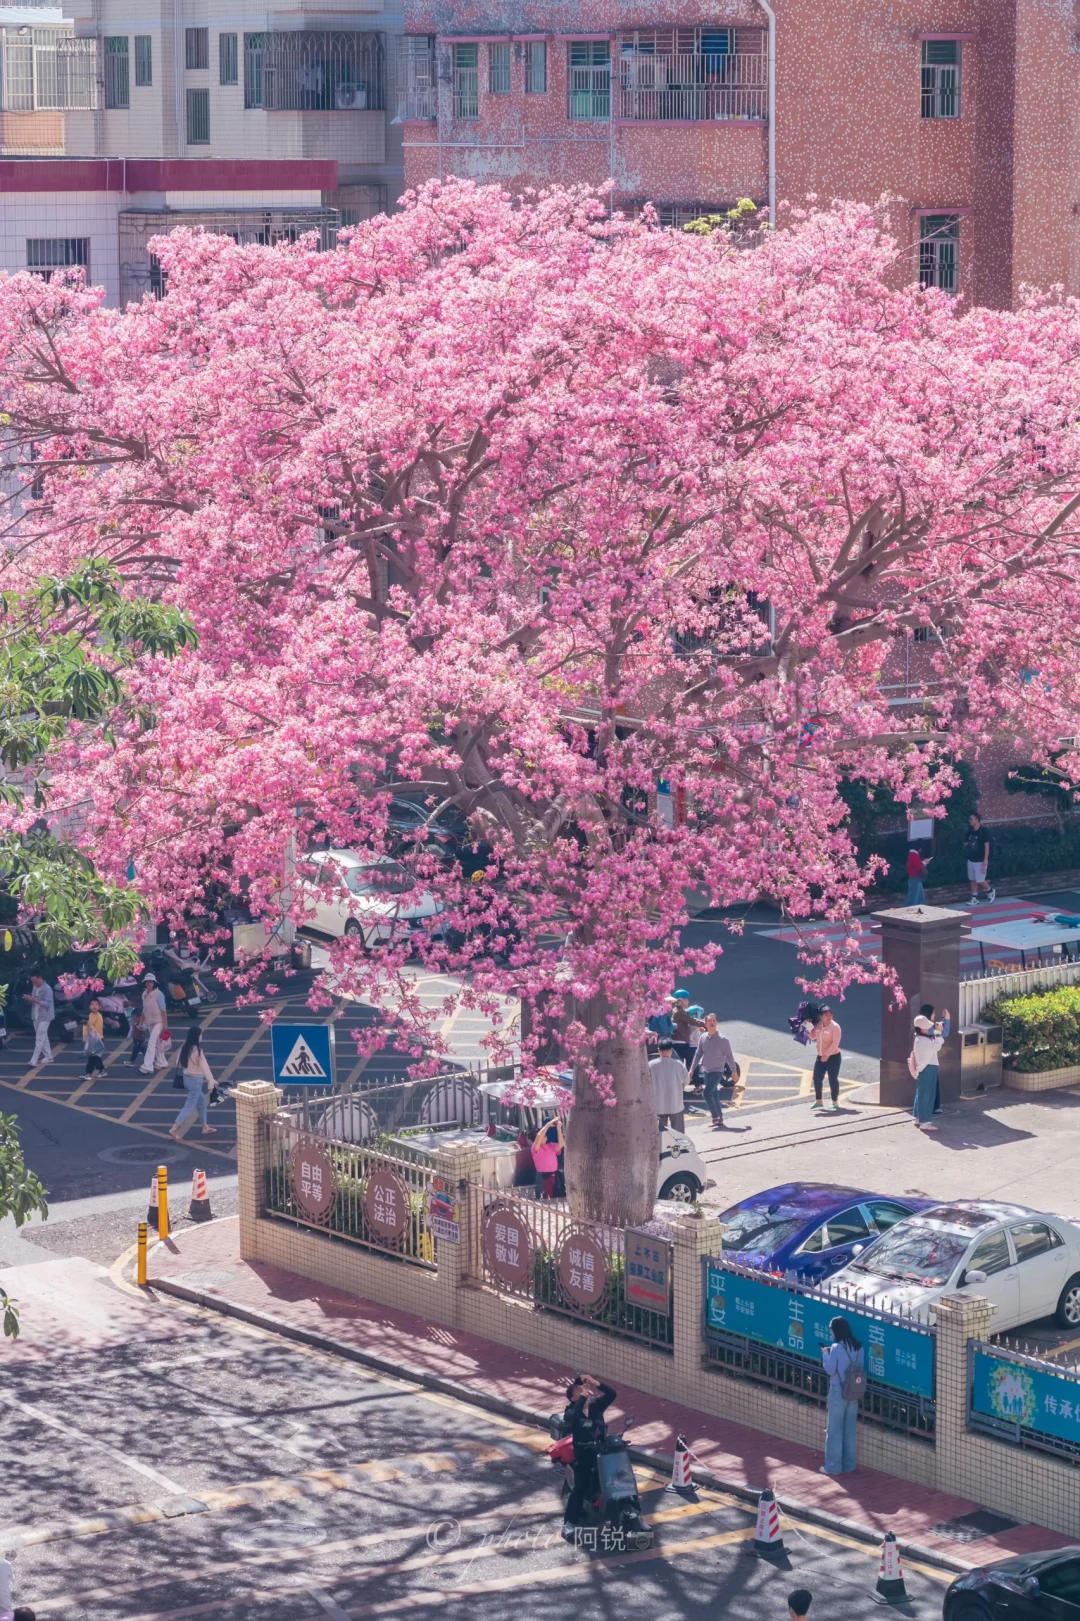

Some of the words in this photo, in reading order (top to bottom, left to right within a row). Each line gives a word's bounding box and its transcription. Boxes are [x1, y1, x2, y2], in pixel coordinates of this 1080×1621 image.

[301, 1161, 323, 1182] 自由
[301, 1179, 323, 1202] 平等
[373, 1184, 396, 1206] 公正
[373, 1203, 396, 1227] 法治
[494, 1223, 520, 1247] 爱国
[494, 1243, 520, 1268] 敬业
[568, 1246, 595, 1273] 诚信
[568, 1268, 595, 1294] 友善
